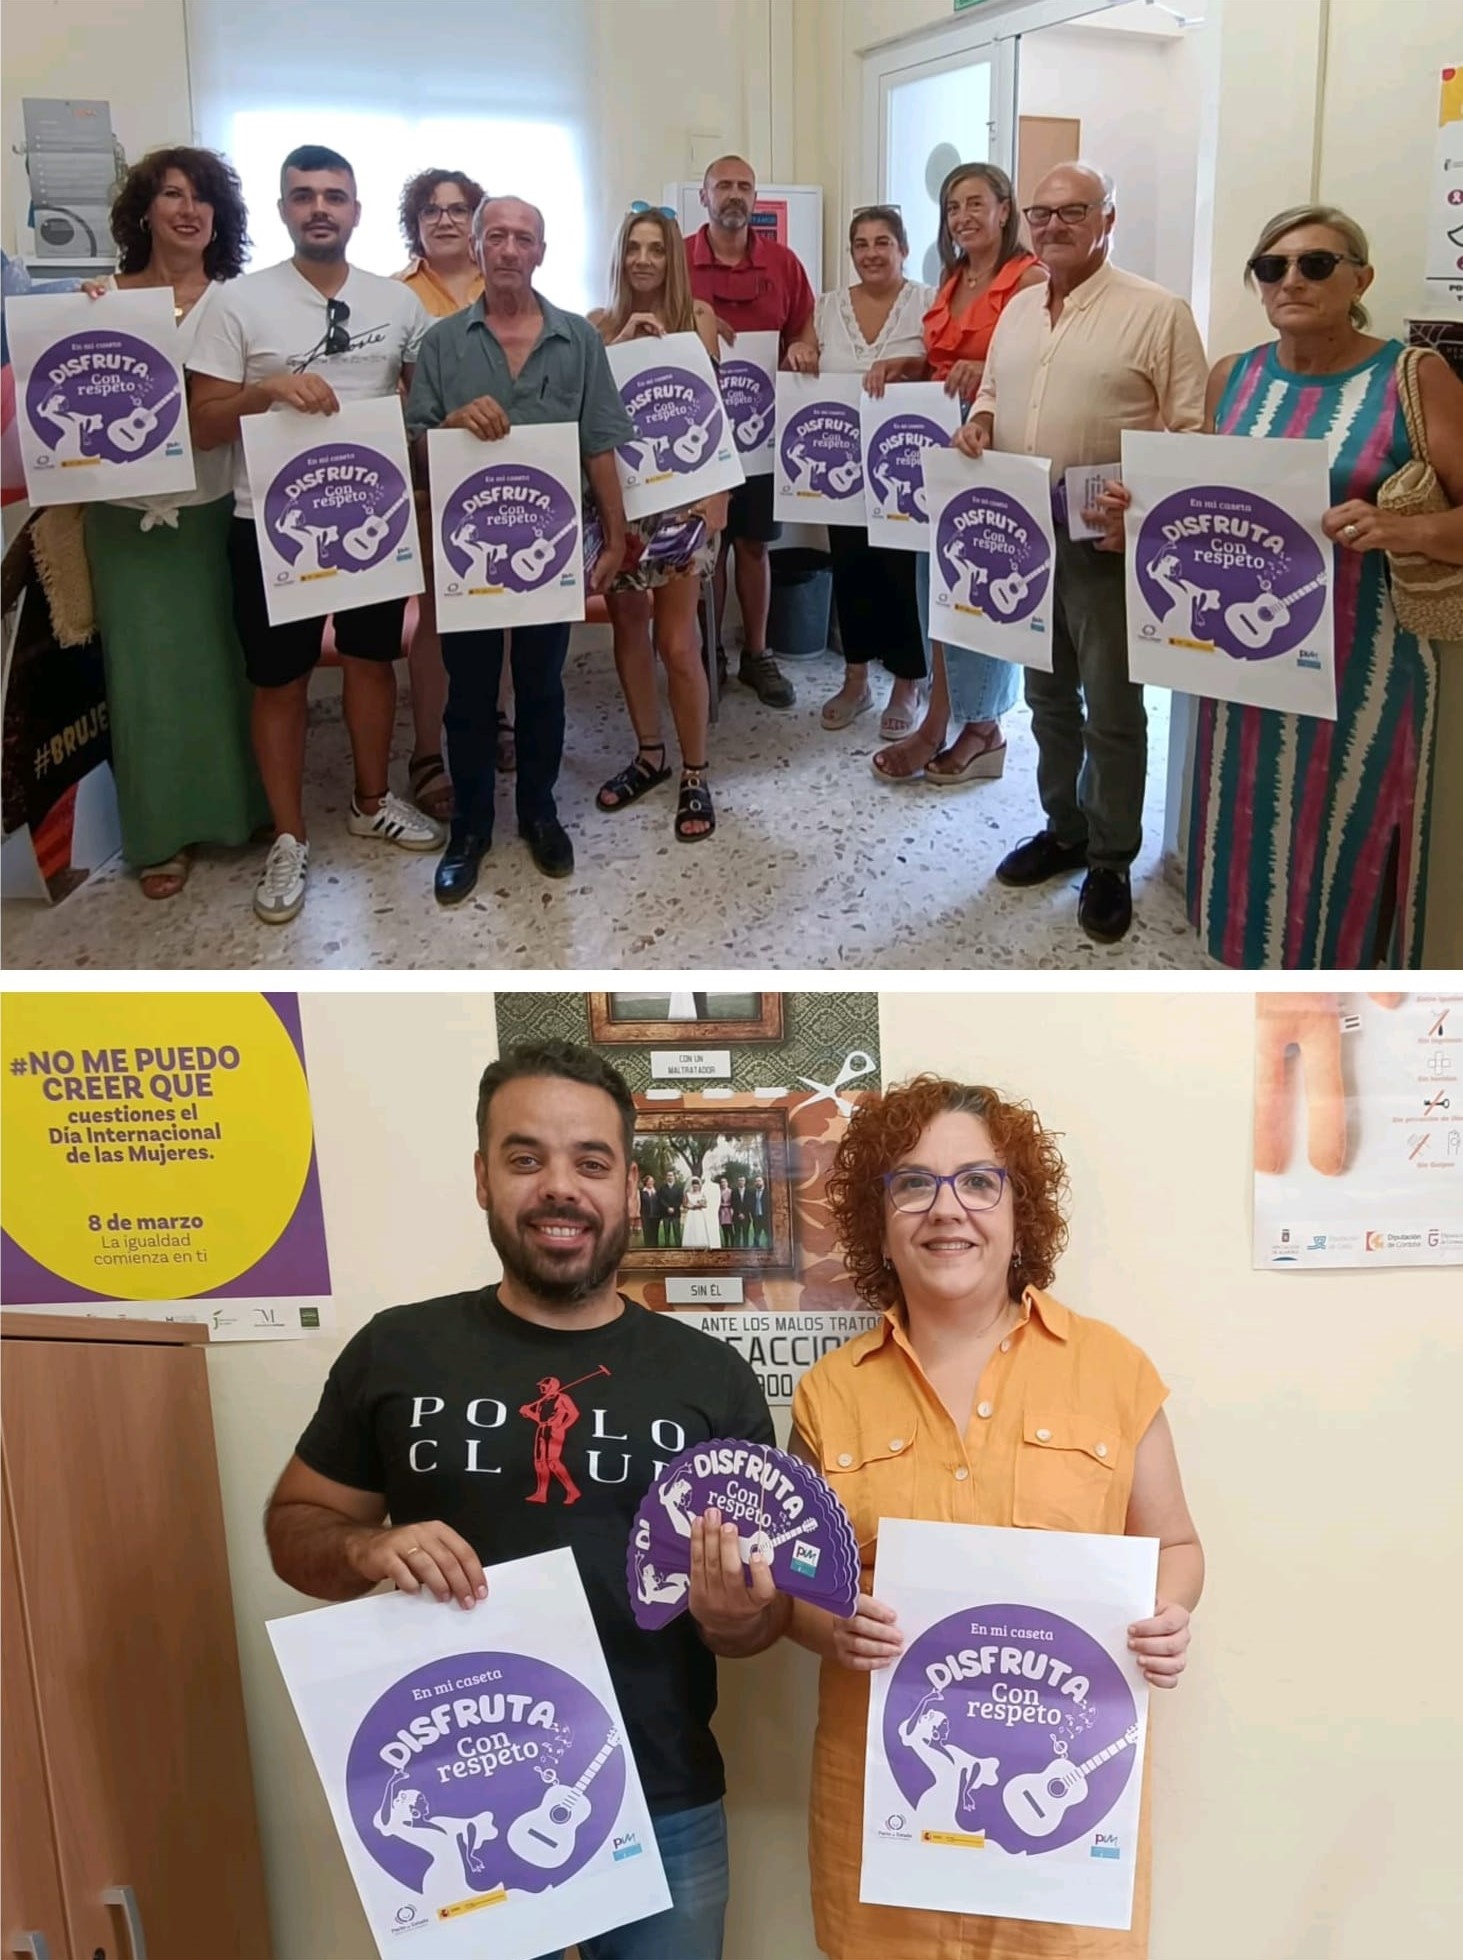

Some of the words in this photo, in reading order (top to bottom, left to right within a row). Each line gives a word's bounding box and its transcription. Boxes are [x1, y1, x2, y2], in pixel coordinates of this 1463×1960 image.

[49, 353, 149, 384] DISFRUTA
[91, 373, 120, 385] Con
[78, 380, 136, 397] respeto
[625, 384, 694, 416] DISFRUTA
[653, 402, 676, 413] Con
[646, 406, 687, 424] respeto
[797, 417, 860, 440] DISFRUTA
[813, 439, 850, 450] respeto
[285, 466, 379, 498] DISFRUTA
[325, 484, 353, 497] Con
[313, 491, 366, 509] respeto
[463, 486, 551, 513] DISFRUTA
[499, 504, 525, 516] Con
[1190, 498, 1202, 508] En
[1204, 500, 1217, 509] mi
[1219, 502, 1252, 512] caseta
[486, 512, 538, 527] respeto
[953, 509, 1028, 544] DISFRUTA
[983, 528, 1006, 542] Con
[1162, 514, 1285, 554] DISFRUTA
[973, 537, 1016, 555] respeto
[1210, 538, 1248, 555] Con
[1194, 549, 1265, 570] respeto
[10, 1050, 75, 1076] #NO
[81, 1048, 129, 1074] ME
[135, 1045, 241, 1072] PUEDO
[679, 1054, 692, 1063] CON
[694, 1054, 704, 1062] UN
[668, 1066, 716, 1074] MALTRATADOR
[42, 1076, 144, 1101] CREER
[150, 1073, 214, 1103] QUE
[67, 1104, 176, 1124] cuestiones
[180, 1102, 198, 1121] el
[48, 1126, 83, 1144] Día
[87, 1122, 222, 1143] Internacional
[66, 1146, 90, 1164] de
[95, 1144, 124, 1162] las
[128, 1143, 215, 1166] Mujeres.
[88, 1214, 102, 1232] 8
[106, 1213, 133, 1231] de
[137, 1215, 204, 1230] marzo
[101, 1235, 120, 1249] La
[124, 1232, 191, 1252] igualdad
[94, 1250, 170, 1266] comienza
[173, 1252, 193, 1264] en
[196, 1248, 208, 1262] ti
[691, 1284, 707, 1296] SIN
[701, 1317, 737, 1332] ANTE
[743, 1317, 770, 1332] LOS
[775, 1316, 824, 1331] MALOS
[694, 1448, 804, 1519] DISFRUTA
[727, 1480, 759, 1508] Con
[707, 1490, 772, 1528] respeto
[970, 1622, 988, 1636] En
[990, 1625, 1008, 1636] mi
[1010, 1628, 1054, 1641] caseta
[926, 1646, 1090, 1702] DISFRUTA
[411, 1688, 432, 1701] En
[434, 1680, 454, 1696] mi
[455, 1669, 503, 1690] caseta
[992, 1682, 1040, 1706] Con
[966, 1700, 1062, 1727] respeto
[380, 1693, 556, 1769] DISFRUTA
[457, 1732, 510, 1758] Con
[437, 1740, 539, 1783] respeto
